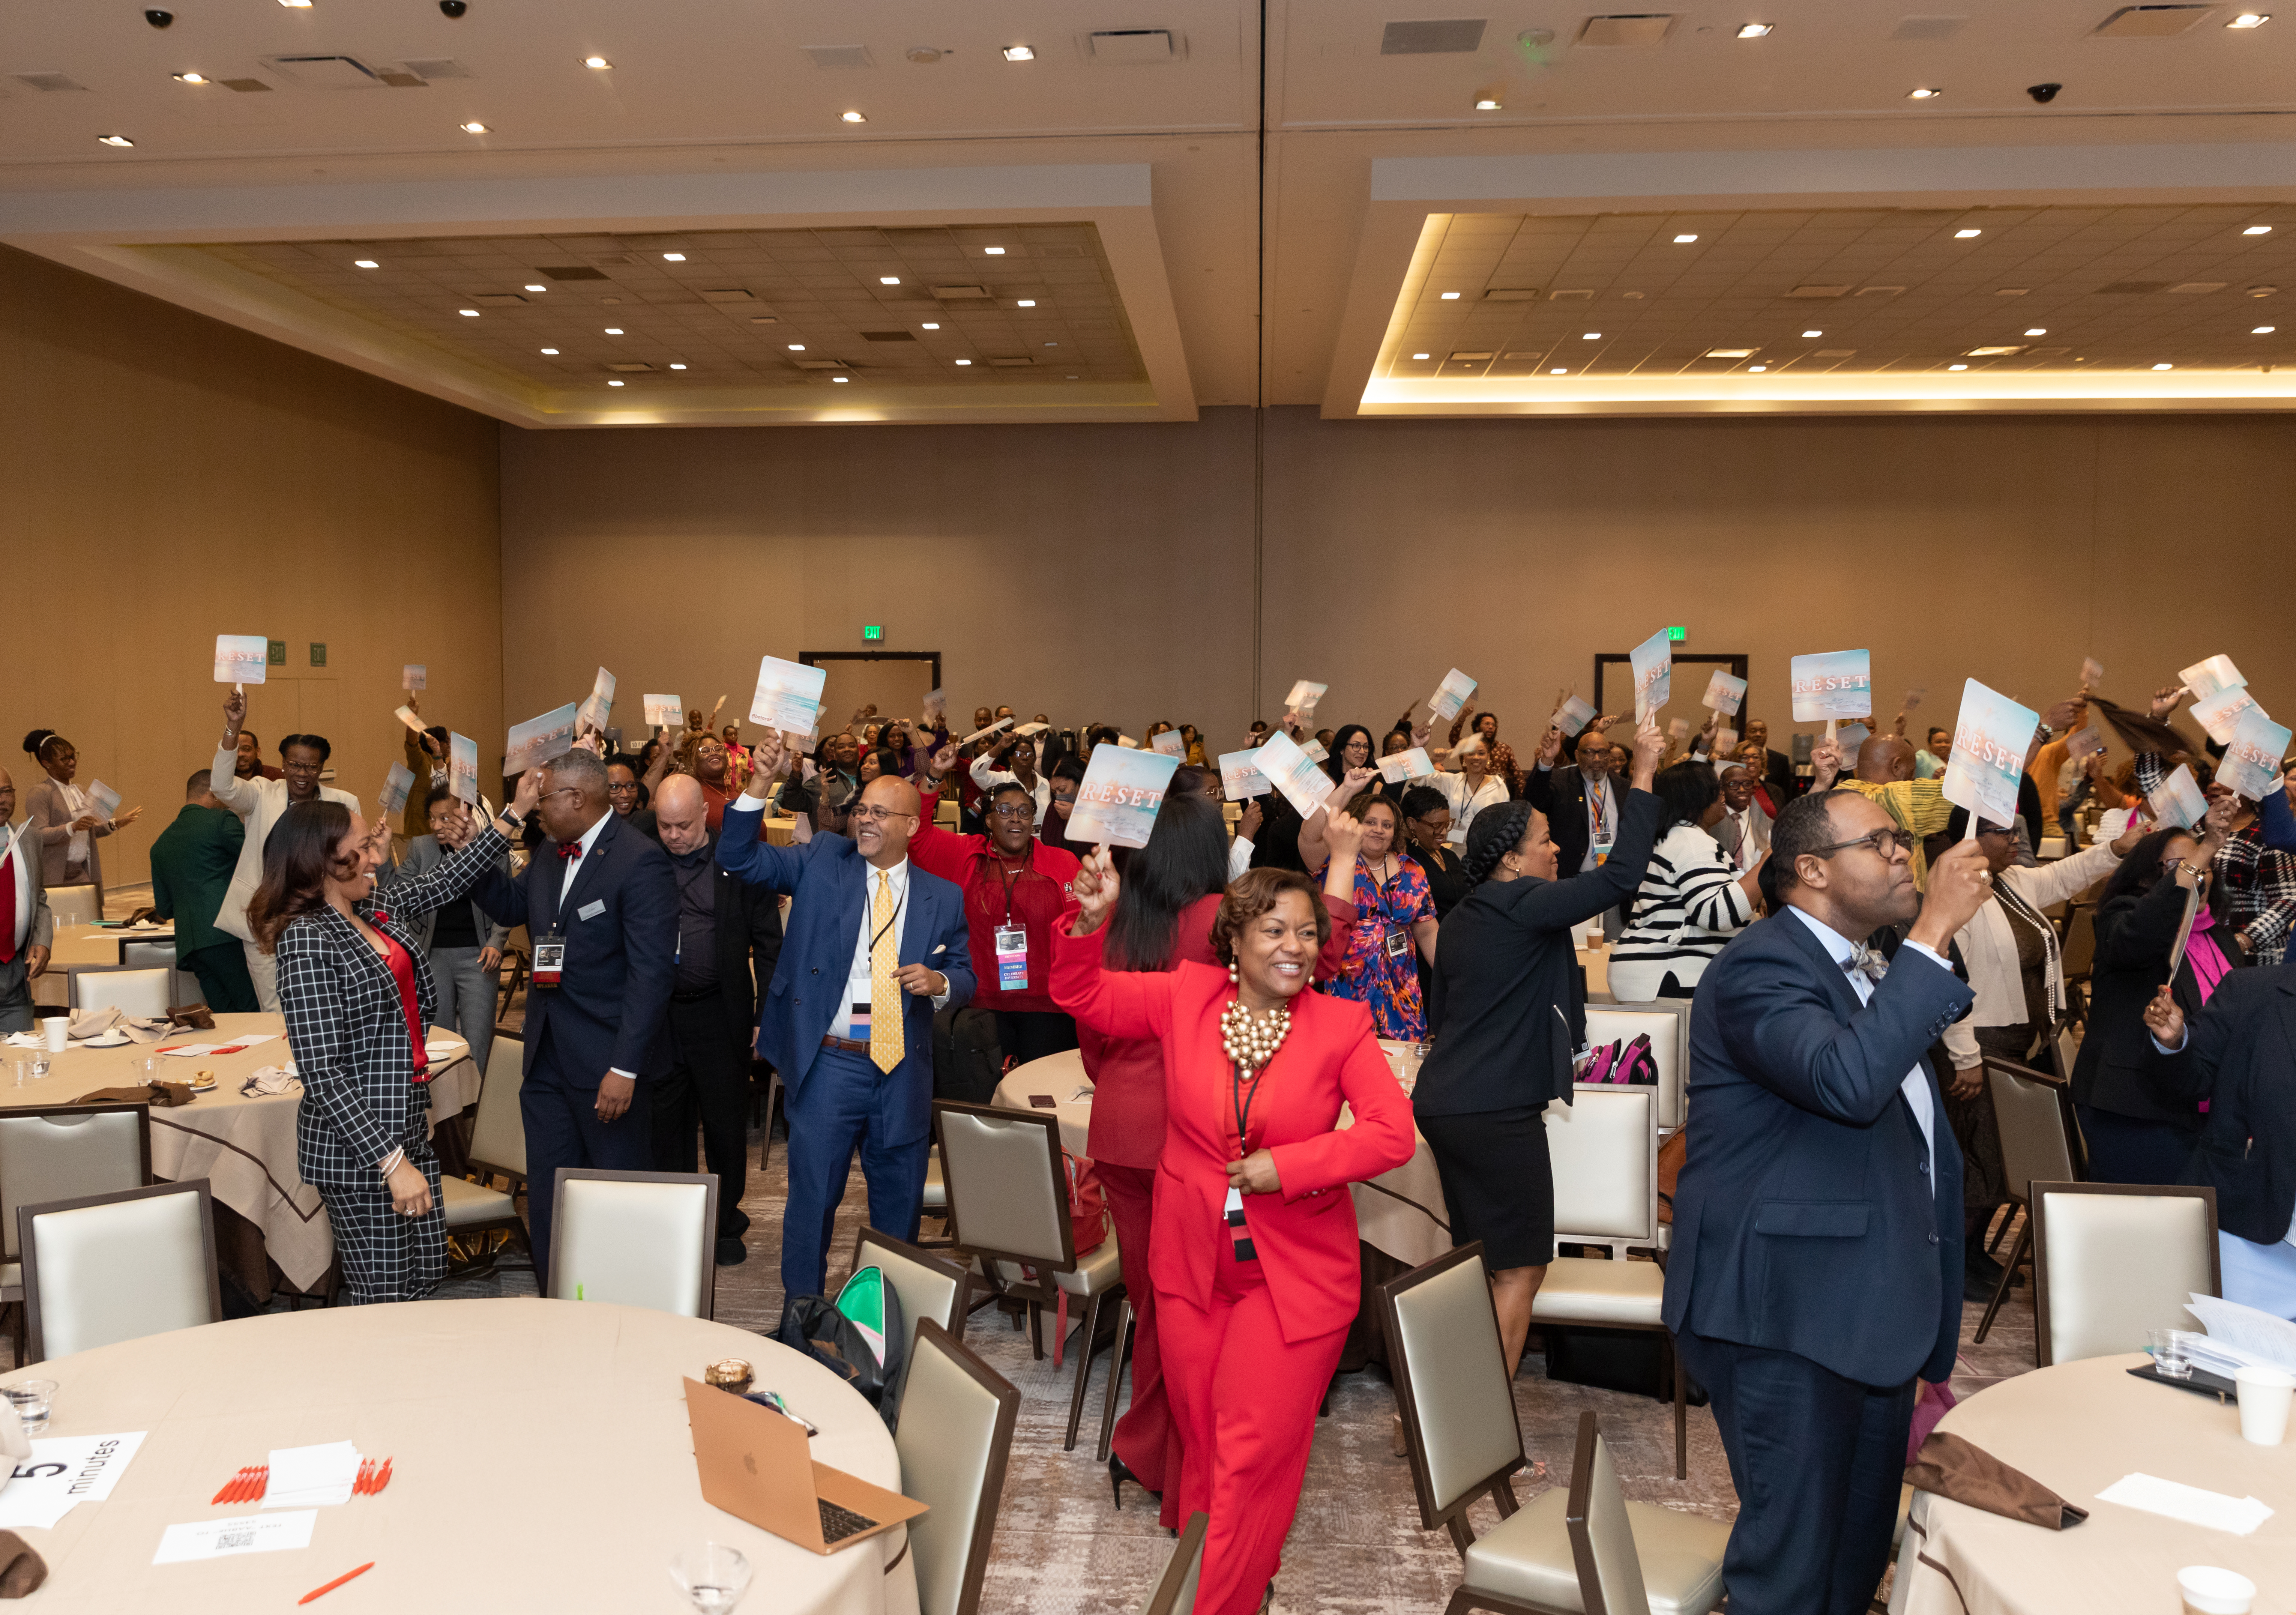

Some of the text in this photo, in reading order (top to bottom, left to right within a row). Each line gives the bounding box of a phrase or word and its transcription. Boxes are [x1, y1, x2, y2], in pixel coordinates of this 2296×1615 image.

[865, 626, 880, 638] EXIT
[1668, 627, 1685, 640] EXIT
[218, 652, 264, 662] RESET
[1637, 658, 1669, 694] RESET
[1795, 675, 1867, 692] RESET
[1708, 685, 1740, 701] RESET
[2203, 697, 2251, 728] RESET
[508, 725, 571, 755] RESET
[1158, 744, 1182, 754] RESET
[1956, 725, 2021, 777] RESET
[2231, 739, 2278, 772] RESET
[452, 758, 476, 779] RESET
[1224, 766, 1263, 781] RESE
[1397, 753, 1416, 778] RESET
[1081, 783, 1161, 808] RESET
[10, 1463, 68, 1478] 5
[67, 1440, 120, 1495] minutes
